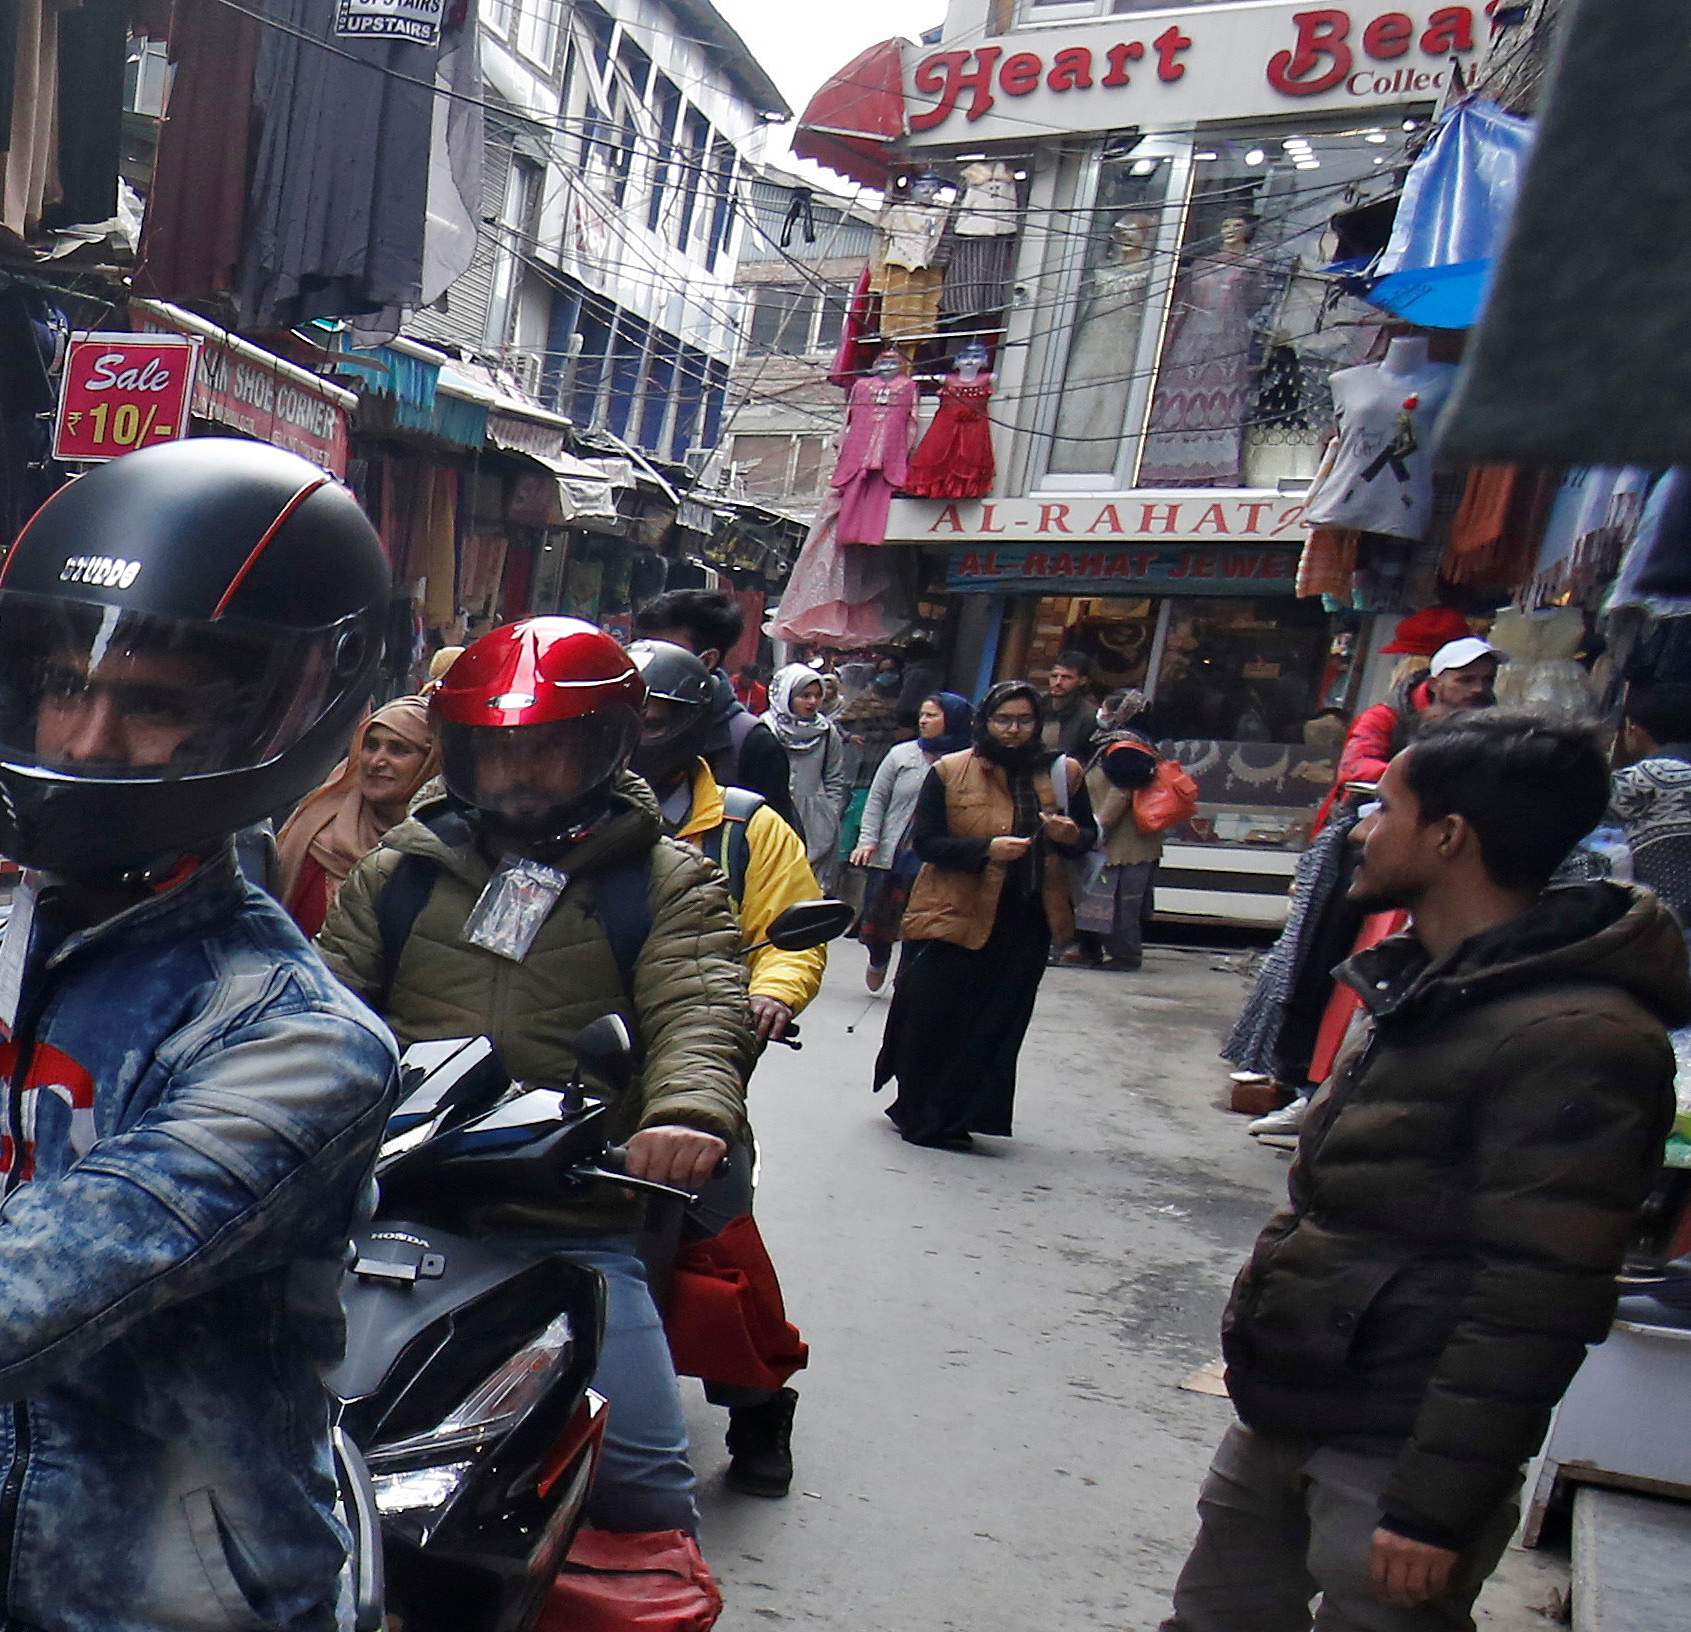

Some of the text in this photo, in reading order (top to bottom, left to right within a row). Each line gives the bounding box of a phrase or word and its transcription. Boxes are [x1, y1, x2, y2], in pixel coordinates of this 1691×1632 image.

[346, 16, 431, 39] UPSTAIRS
[906, 25, 1193, 134] Heart
[85, 353, 170, 392] Sale
[234, 362, 273, 412] SHOE
[277, 386, 337, 440] CORNER
[928, 503, 1273, 536] AL-RAHAT
[957, 551, 1160, 579] AL-RAHAT
[370, 1231, 431, 1249] HONDA
